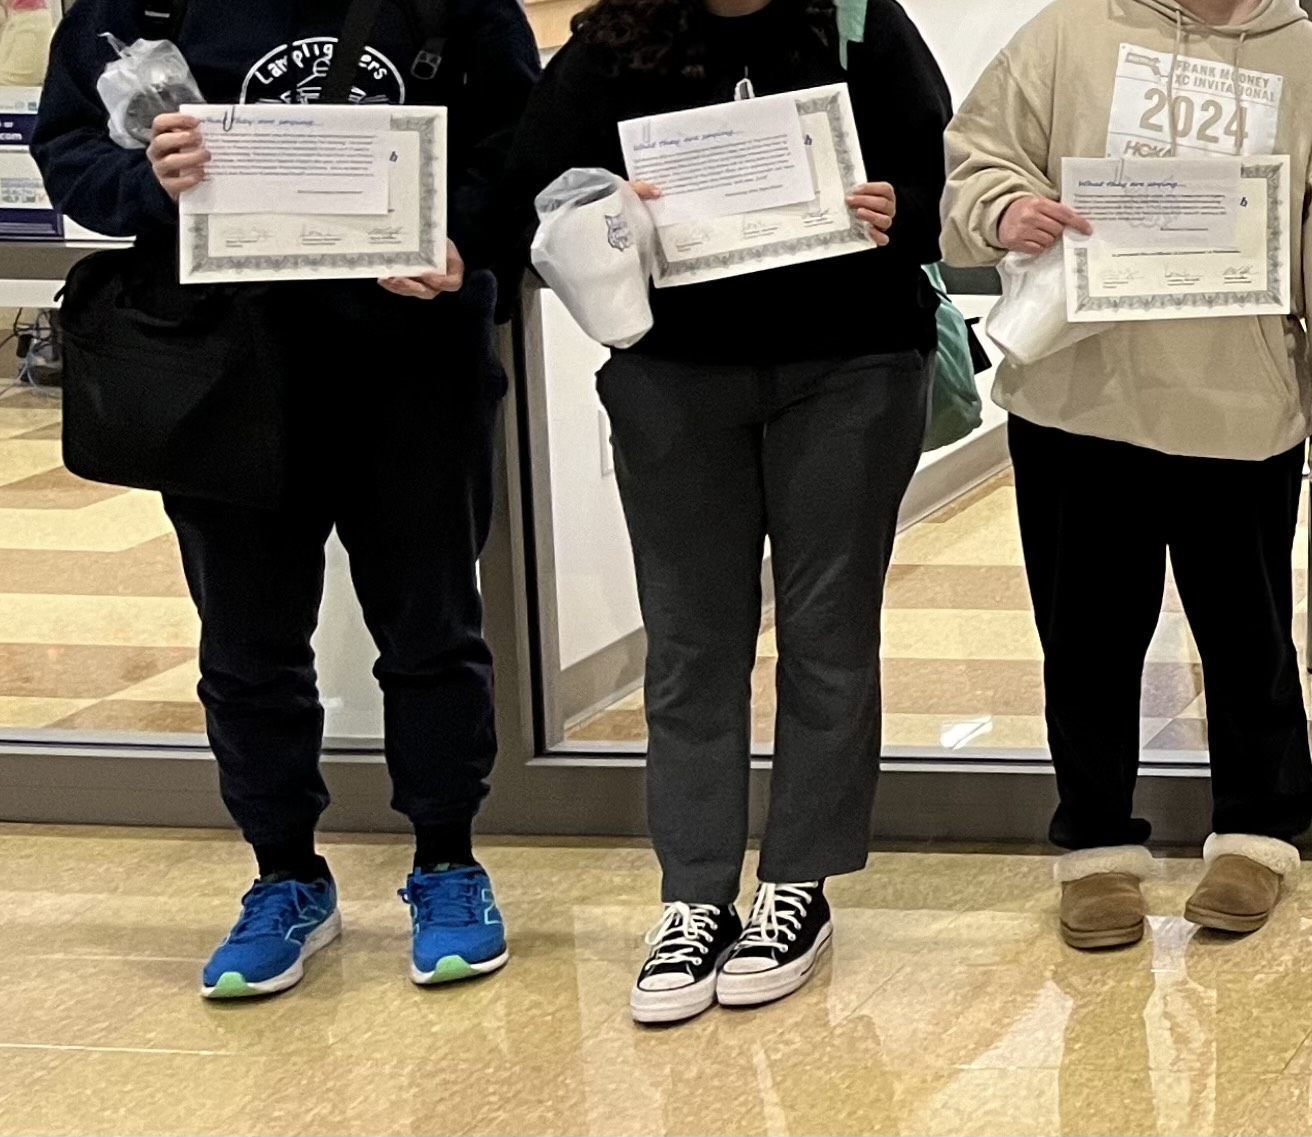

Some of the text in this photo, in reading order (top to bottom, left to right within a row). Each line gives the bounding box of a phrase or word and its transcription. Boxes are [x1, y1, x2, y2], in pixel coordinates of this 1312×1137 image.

[1174, 59, 1216, 77] FRANK
[1174, 74, 1190, 86] XC
[1138, 87, 1249, 149] 2024
